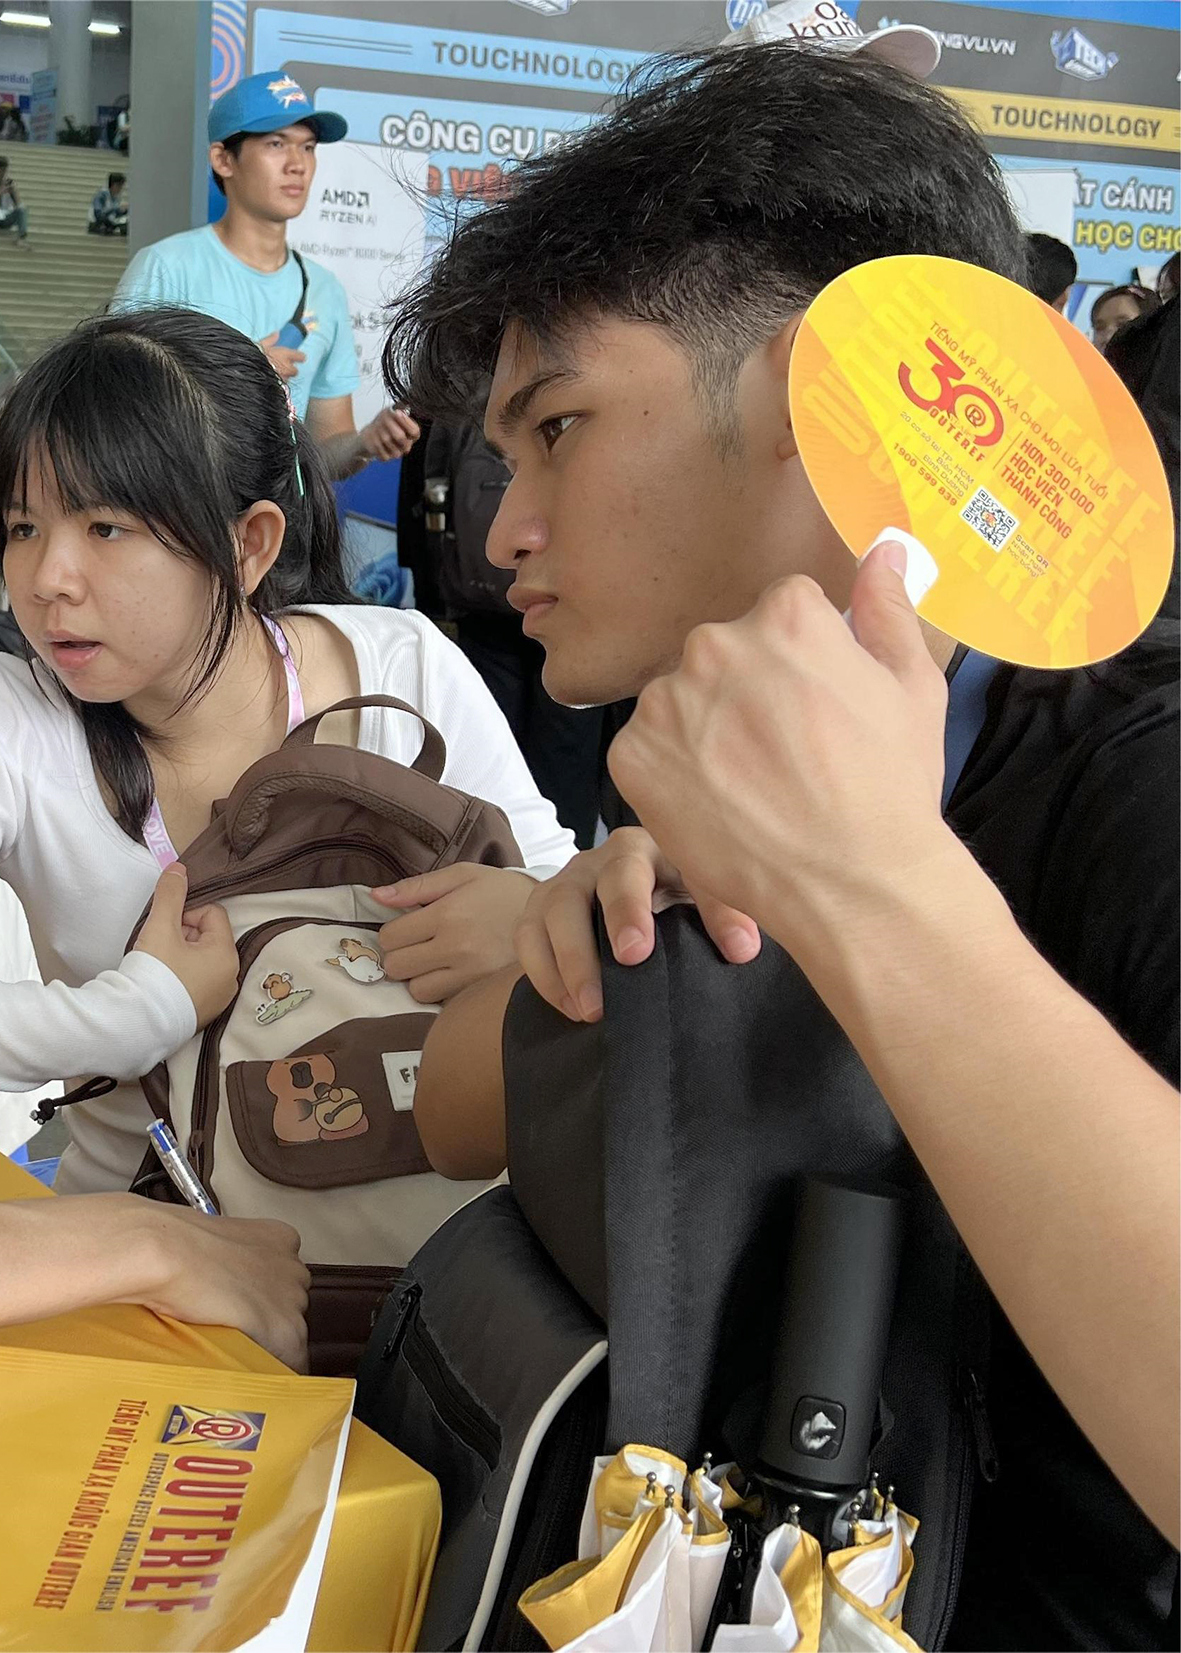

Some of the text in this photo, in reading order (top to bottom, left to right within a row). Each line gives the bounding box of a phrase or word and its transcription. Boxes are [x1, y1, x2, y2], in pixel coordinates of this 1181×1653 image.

[432, 41, 643, 83] TOUCHNOLOGY
[381, 110, 483, 154] CÔNG
[991, 104, 1162, 138] TOUCHNOLOGY
[320, 210, 364, 225] RYZEN
[1102, 177, 1174, 213] CÁNH
[1075, 220, 1133, 255] HỌC
[929, 320, 959, 352] TIẾNG
[975, 365, 1005, 398] PHẢN
[1019, 411, 1042, 435] CHO
[1041, 431, 1063, 456] MỌI
[929, 407, 986, 463] OUTEREF
[893, 442, 958, 507] 1900 599 839
[940, 471, 965, 498] Dương
[954, 464, 975, 485] HCM
[1009, 452, 1065, 508] HỌC VIÊN
[1019, 438, 1095, 515] HƠN 300.000
[1000, 464, 1073, 540] THÀNH CÔNG
[1015, 534, 1050, 569] Scan QR
[139, 1452, 170, 1498] OUTERSPACE
[33, 1399, 150, 1611] TIẾNG MỸ PHẢN XẠ KHÔNG GIAN OUTEREF
[123, 1455, 256, 1614] OUTEREF
